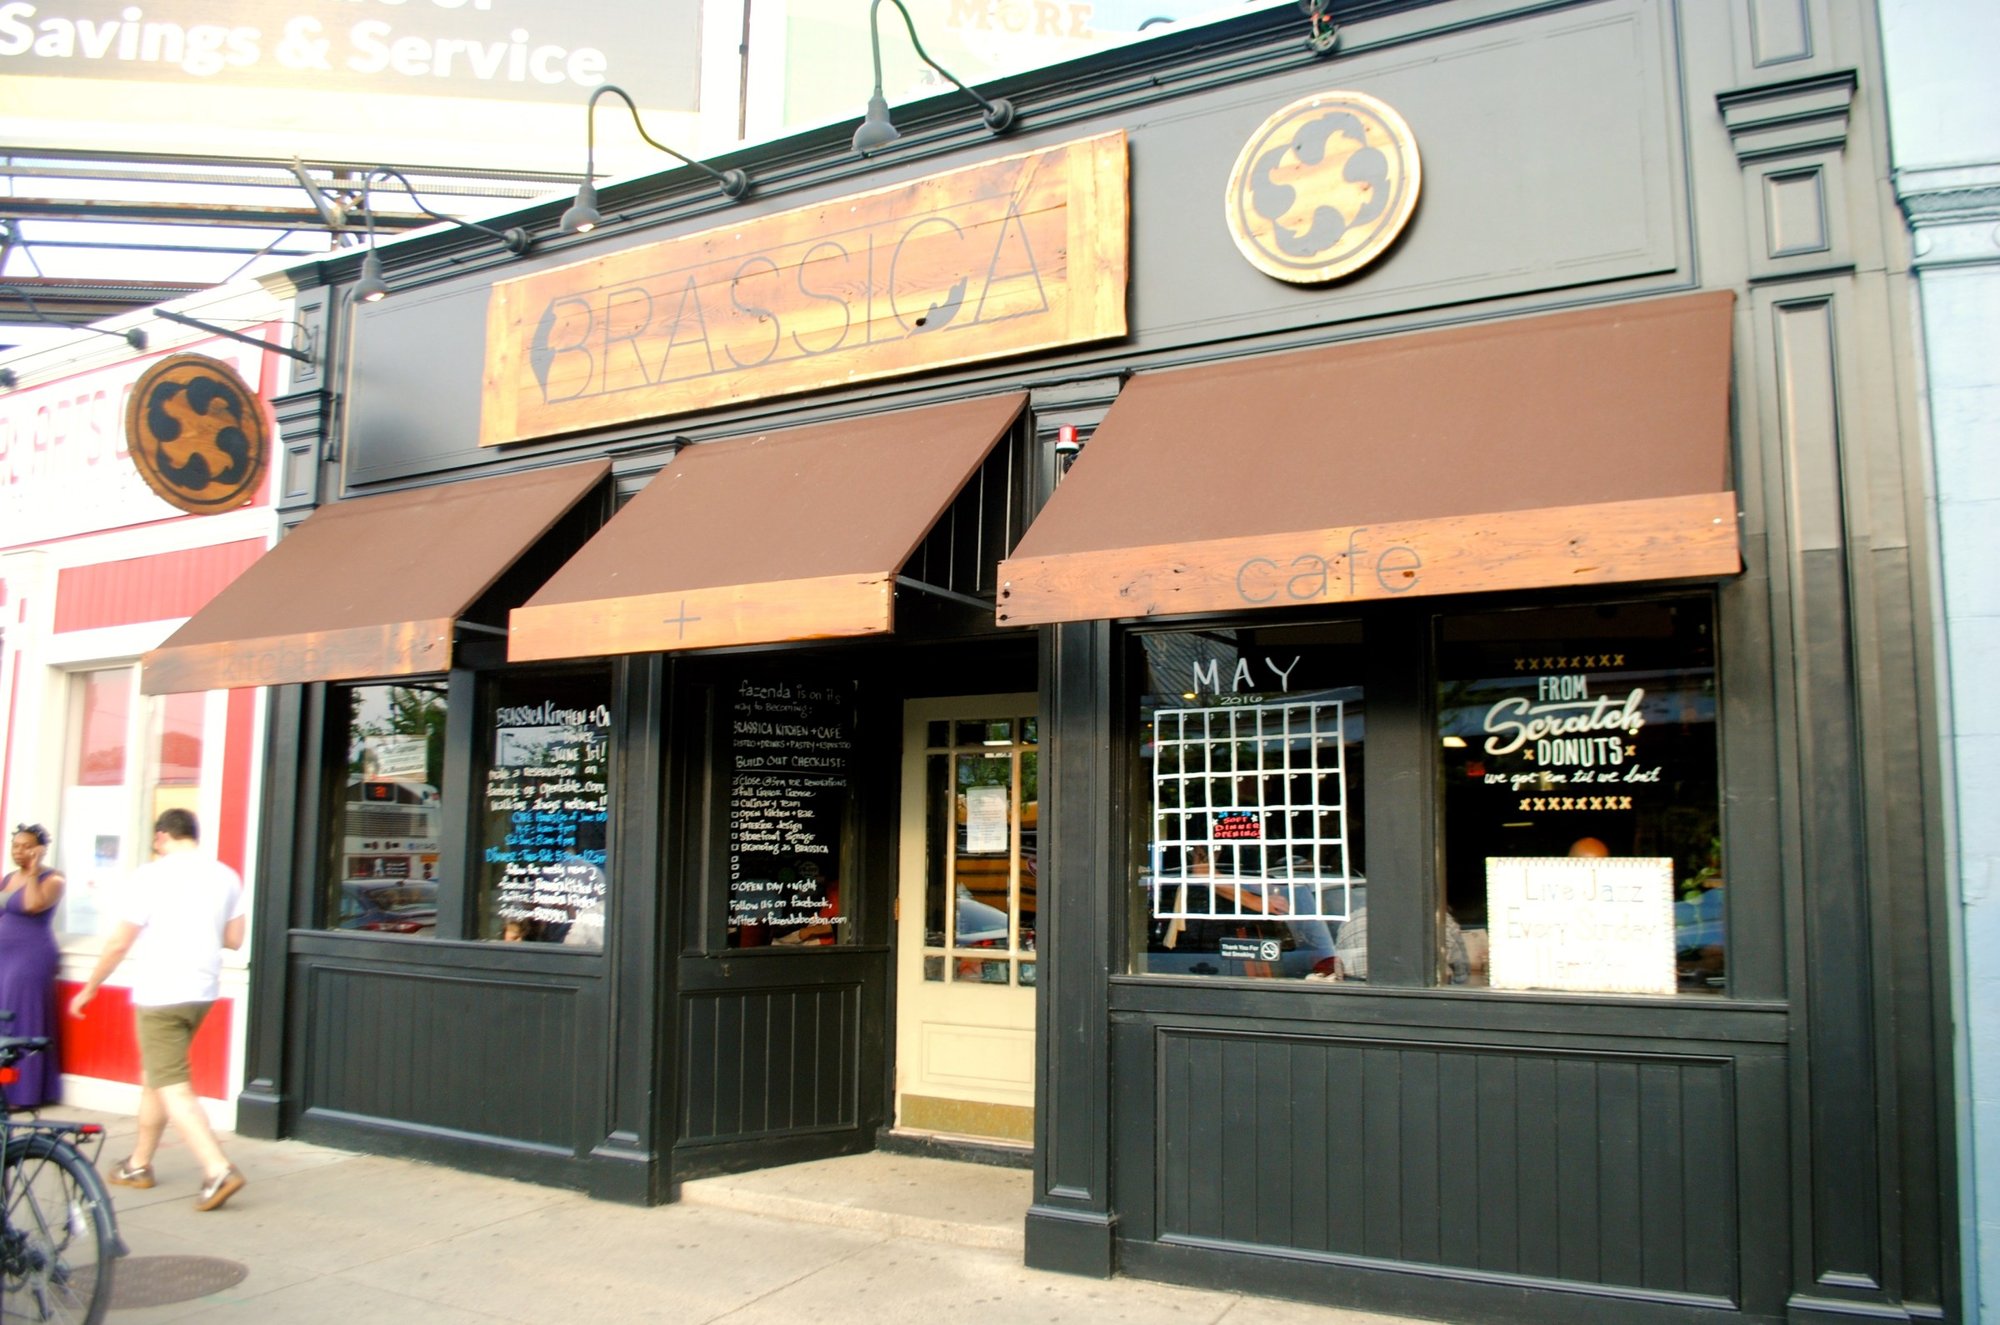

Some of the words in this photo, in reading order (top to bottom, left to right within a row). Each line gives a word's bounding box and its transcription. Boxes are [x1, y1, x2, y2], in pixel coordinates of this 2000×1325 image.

[947, 0, 1095, 40] MORE
[0, 3, 262, 76] Savings
[274, 15, 333, 71] &
[346, 19, 608, 87] Service
[530, 192, 1049, 407] BRASSICA
[1236, 527, 1424, 604] cafe
[1193, 655, 1301, 695] MAY
[1538, 674, 1589, 701] FROM
[738, 679, 791, 699] fazenda
[796, 683, 807, 699] is
[808, 690, 822, 701] on
[1220, 696, 1263, 706] 2016
[734, 702, 752, 717] way
[754, 701, 763, 711] to
[1483, 687, 1646, 757] Scratch
[775, 722, 809, 736] KITCHEN
[766, 756, 788, 766] OUT
[1537, 736, 1624, 768] DONUTS
[1484, 773, 1508, 784] we
[1510, 772, 1539, 791] got
[1596, 772, 1620, 783] we
[1214, 823, 1260, 832] DINNER
[1523, 867, 1575, 902] Live
[1583, 867, 1645, 903] Jazz
[774, 900, 787, 908] on
